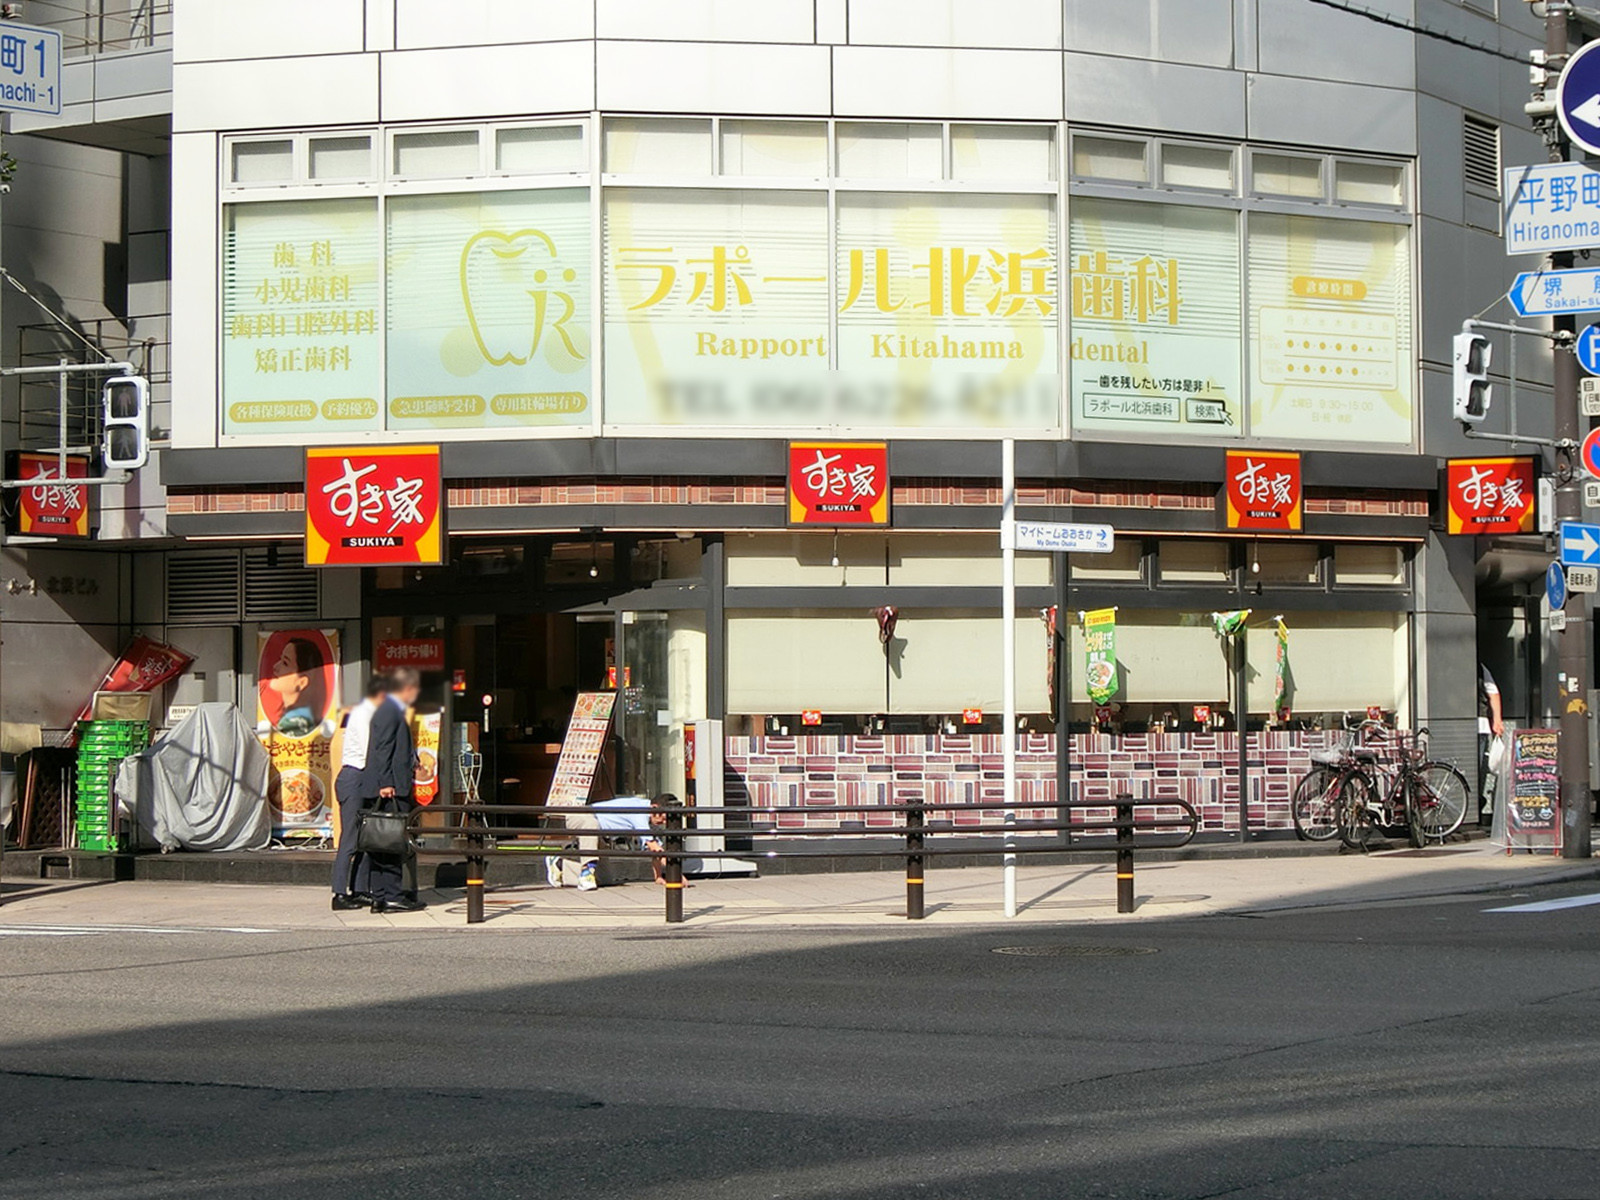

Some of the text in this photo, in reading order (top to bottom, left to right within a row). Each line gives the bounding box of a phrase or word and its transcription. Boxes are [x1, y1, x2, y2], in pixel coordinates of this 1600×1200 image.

[1, 35, 45, 78] 町1
[1513, 221, 1600, 242] Hiranoma
[273, 239, 334, 267] 歯科
[255, 275, 351, 305] 小児歯科
[614, 246, 1184, 326] ラポール北浜歯科
[255, 345, 351, 374] 矯正歯科
[695, 332, 1150, 364] Rapport Kitahama dental
[1089, 397, 1173, 416] ラポール北浜歯科
[802, 449, 877, 503] すき家
[1235, 458, 1292, 510] すき家
[1457, 465, 1525, 515] すき家
[322, 458, 424, 534] すき家
[349, 537, 395, 546] SUKIYA
